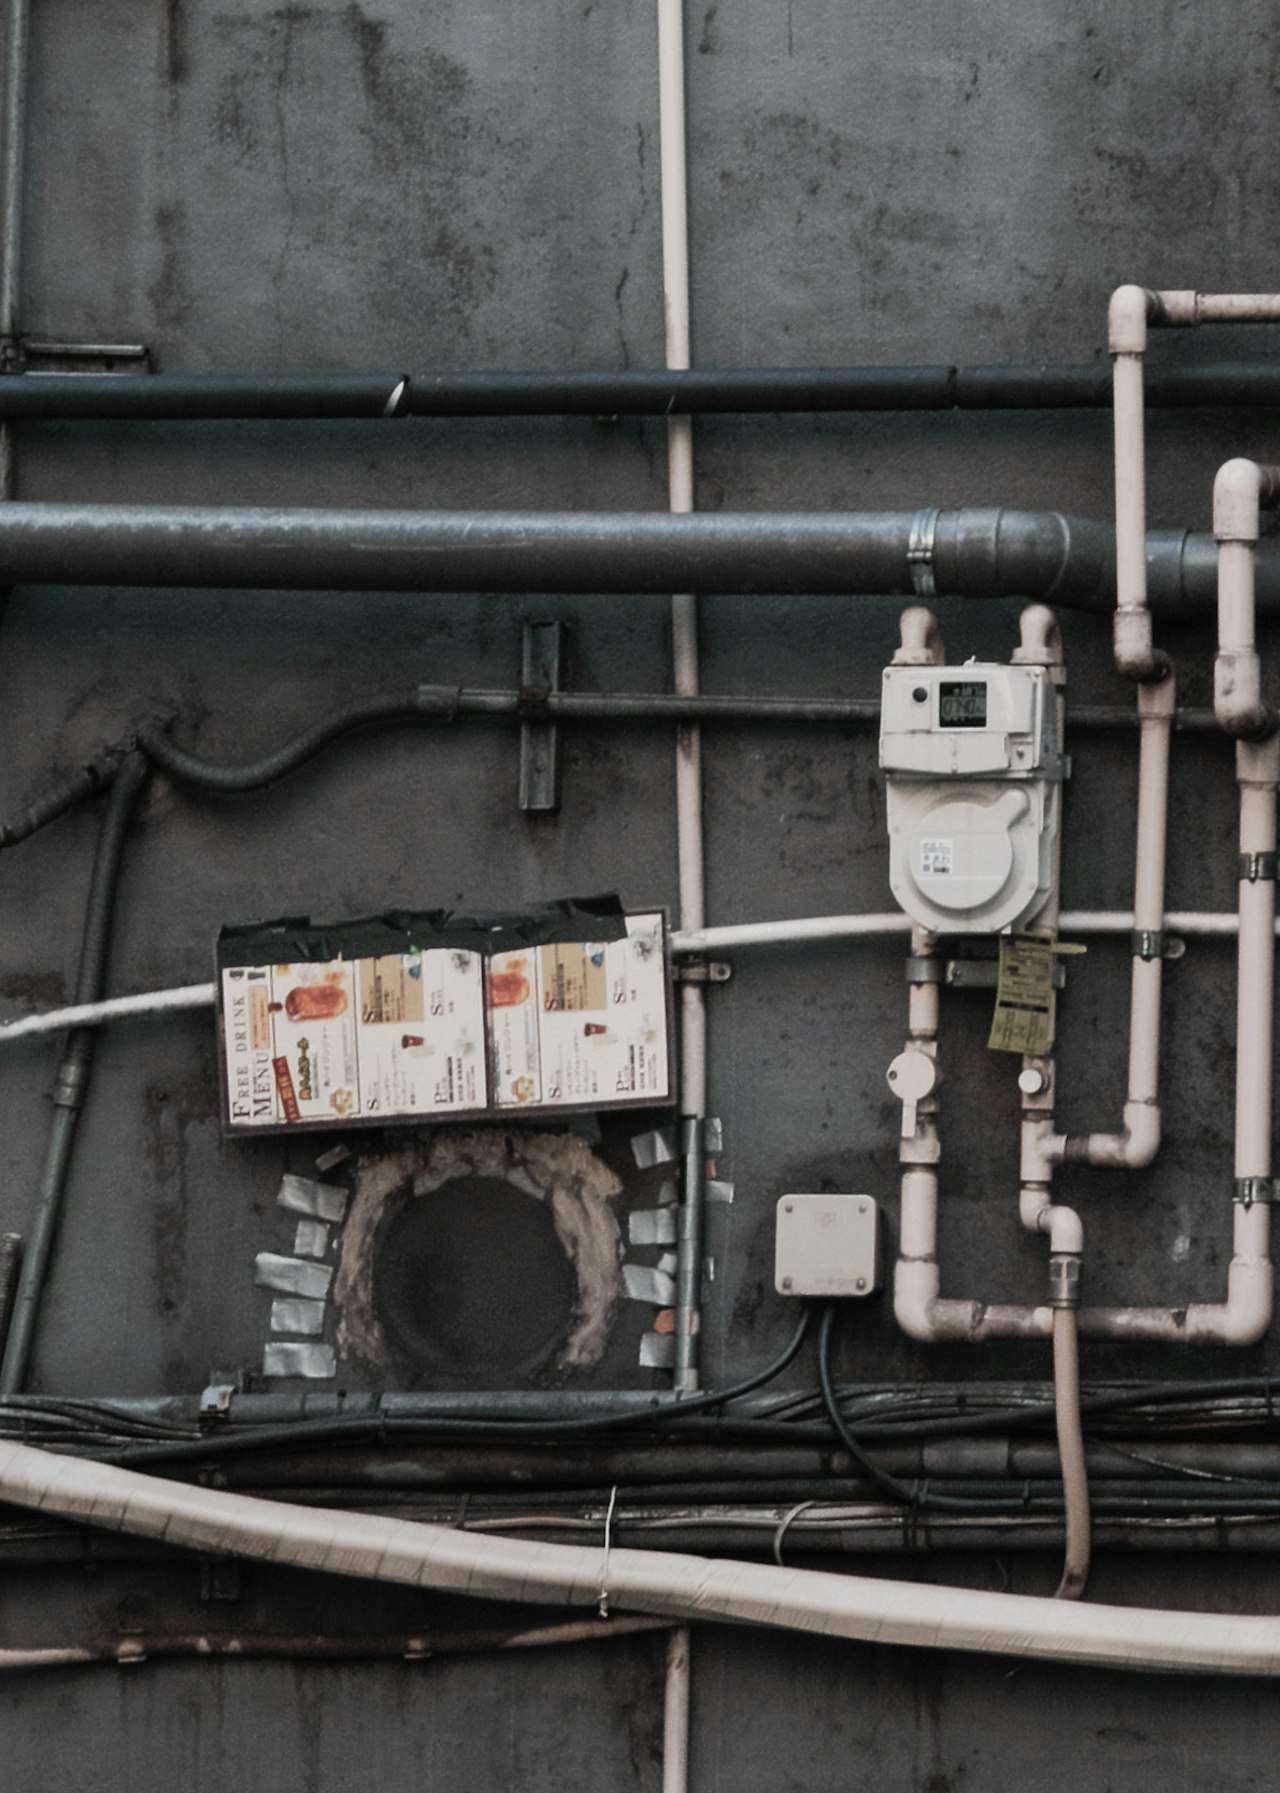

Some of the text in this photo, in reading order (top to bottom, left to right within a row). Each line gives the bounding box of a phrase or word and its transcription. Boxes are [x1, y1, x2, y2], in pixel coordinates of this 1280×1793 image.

[232, 996, 250, 1119] FREE DRINK
[253, 1052, 272, 1118] MENU
